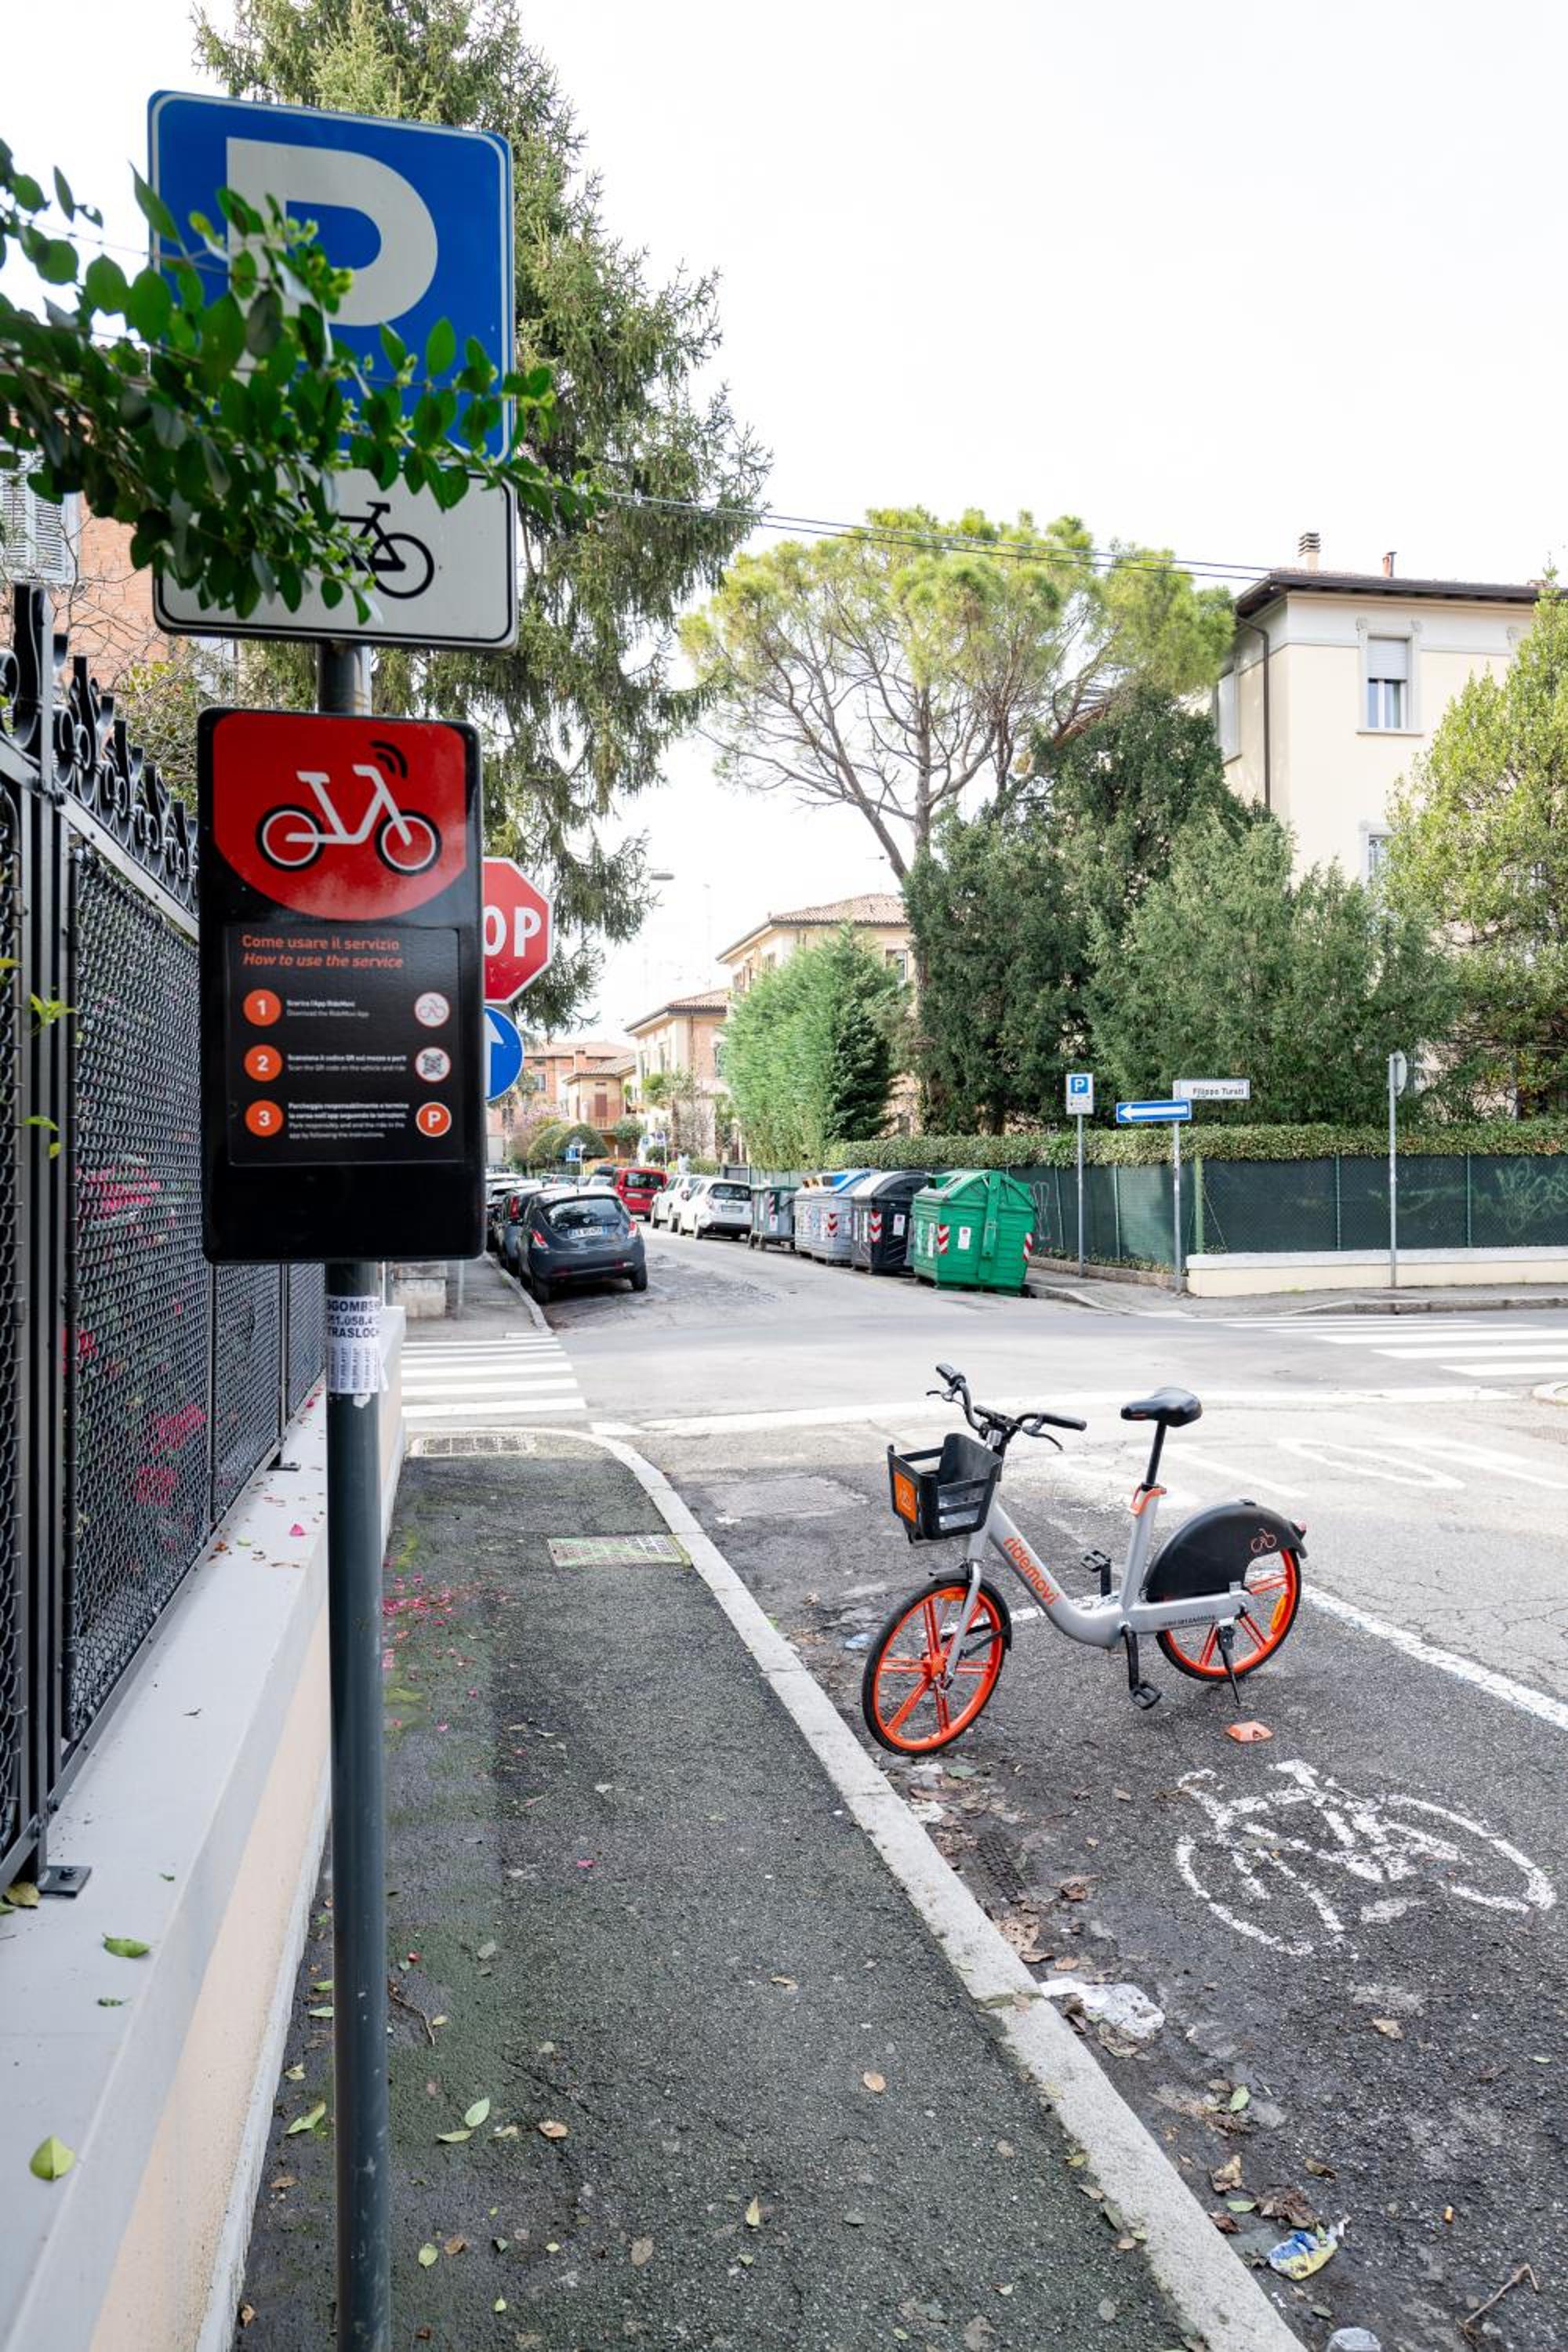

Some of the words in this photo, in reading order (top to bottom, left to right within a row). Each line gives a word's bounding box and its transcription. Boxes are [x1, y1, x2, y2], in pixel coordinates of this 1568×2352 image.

[227, 137, 438, 382] P
[483, 905, 542, 957] OP
[241, 935, 284, 949] Come
[288, 938, 328, 950] usare
[331, 936, 341, 949] il
[344, 936, 400, 951] servizio
[243, 953, 277, 967] How
[279, 954, 293, 966] to
[296, 956, 322, 967] use
[325, 954, 350, 967] the
[352, 956, 403, 968] service
[256, 999, 266, 1016] 1
[256, 1054, 269, 1073] 2
[1075, 1078, 1085, 1092] P
[258, 1109, 270, 1127] 3
[426, 1110, 441, 1128] P
[1003, 1536, 1058, 1606] ridemovi
